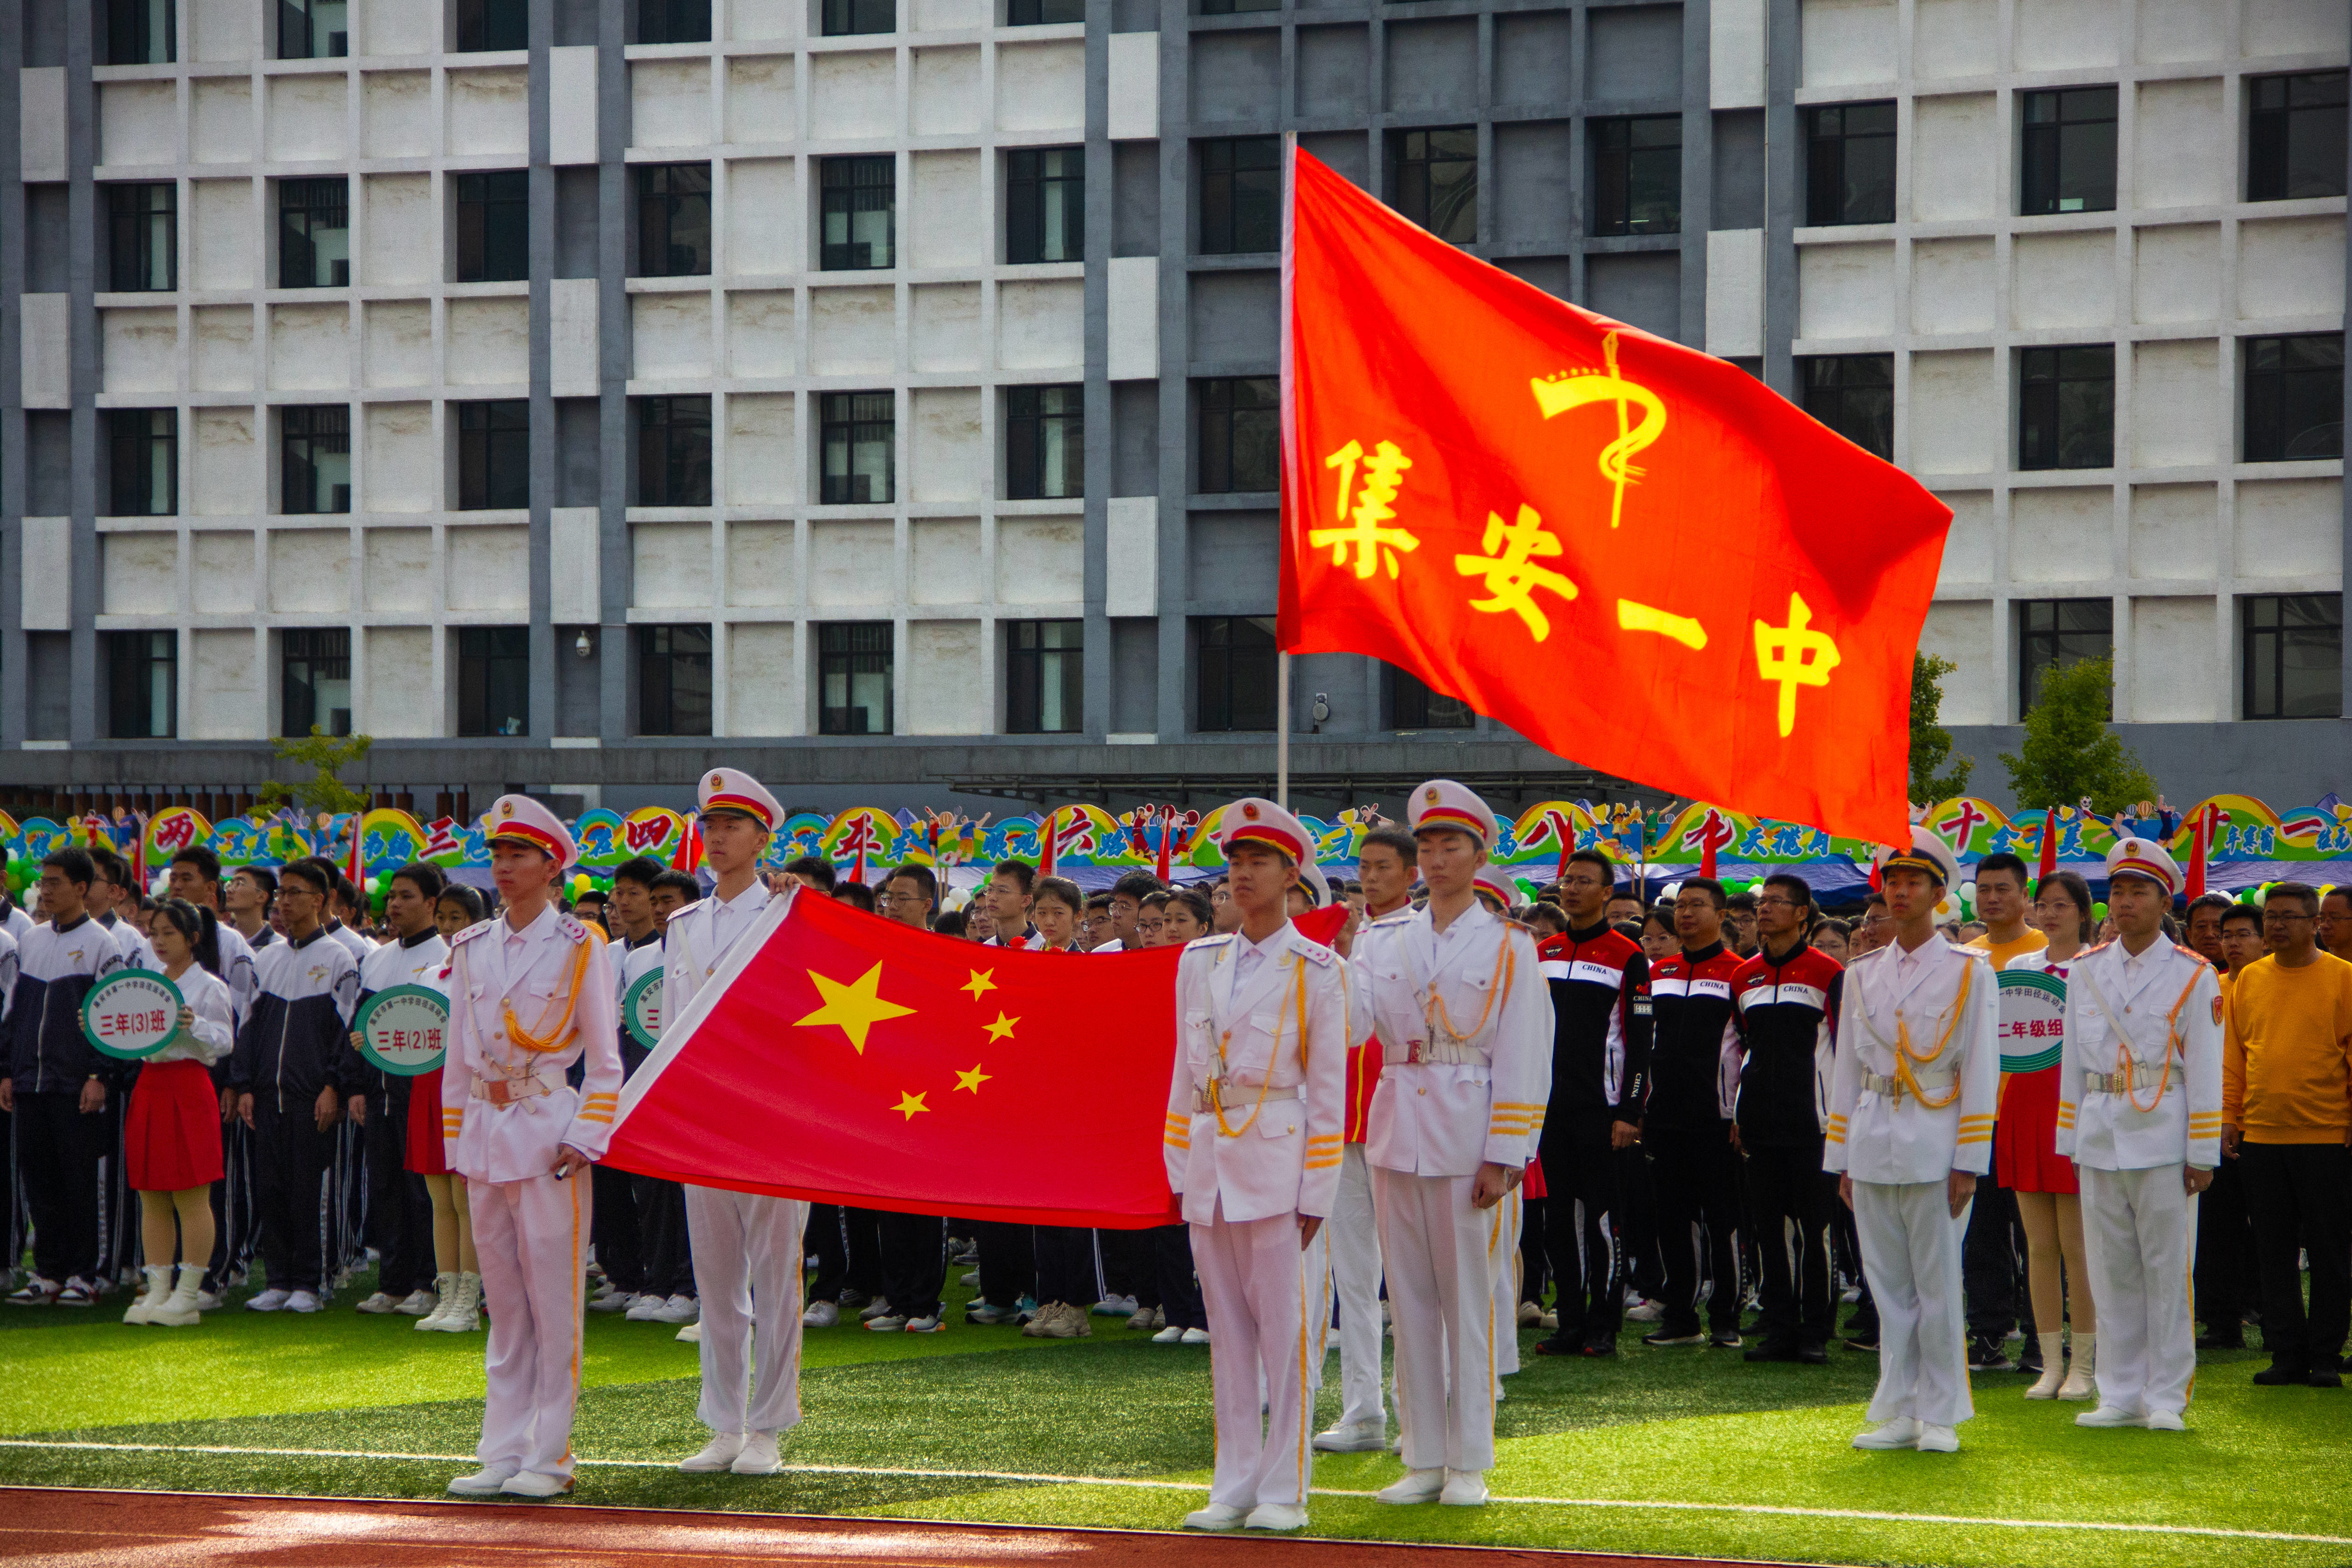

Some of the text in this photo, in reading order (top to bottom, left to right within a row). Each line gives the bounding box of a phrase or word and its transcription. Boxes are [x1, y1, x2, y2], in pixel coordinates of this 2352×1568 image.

[1309, 440, 1841, 737] 集安一中
[1582, 964, 1606, 974] CHINA
[1784, 985, 1808, 994] CHINA
[100, 1009, 166, 1036] 三年(3)班
[377, 1028, 442, 1052] 三年(2)班
[1630, 1073, 1642, 1098] CHINA
